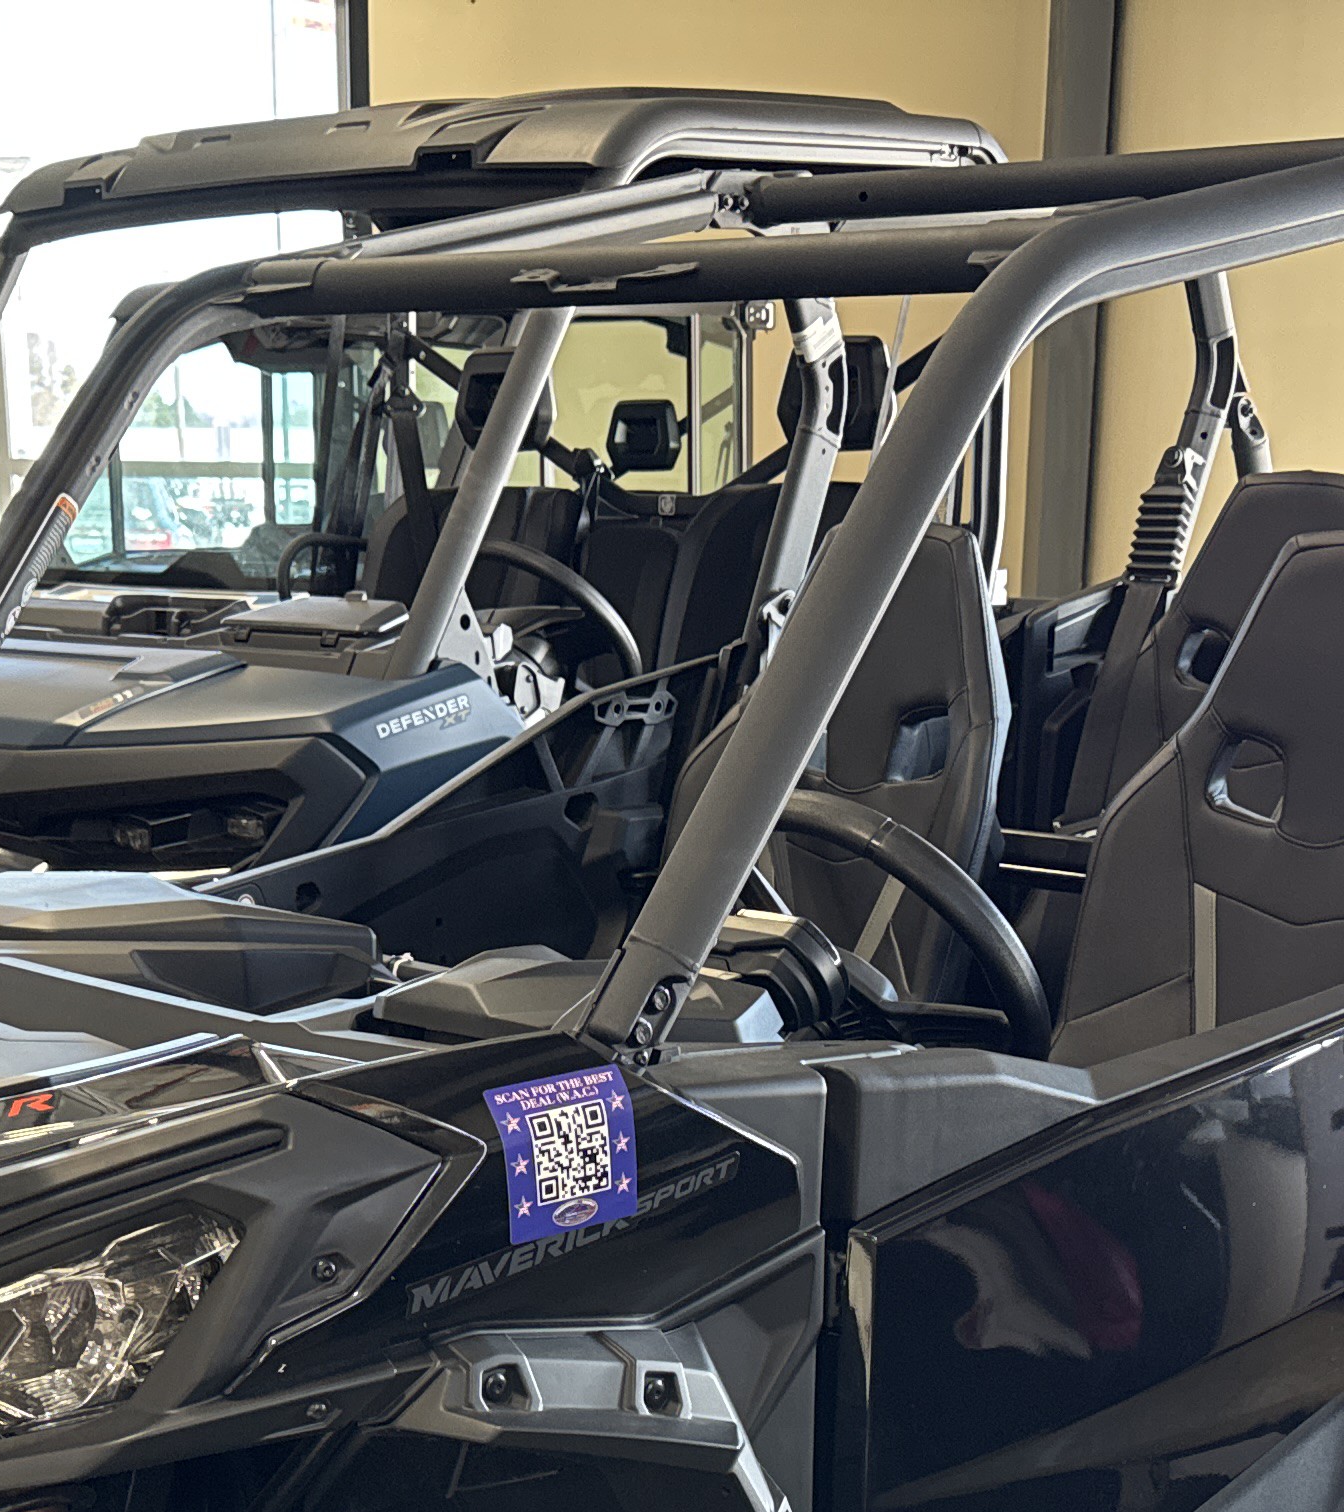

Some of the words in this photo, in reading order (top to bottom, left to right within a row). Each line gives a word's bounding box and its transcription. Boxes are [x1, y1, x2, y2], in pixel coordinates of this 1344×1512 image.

[376, 695, 470, 739] DEFENDER
[443, 710, 470, 728] XT
[494, 1090, 530, 1105] SCAN
[531, 1082, 557, 1097] FOR
[556, 1076, 584, 1091] THE
[583, 1070, 614, 1086] BEST
[520, 1094, 557, 1111] DEAL
